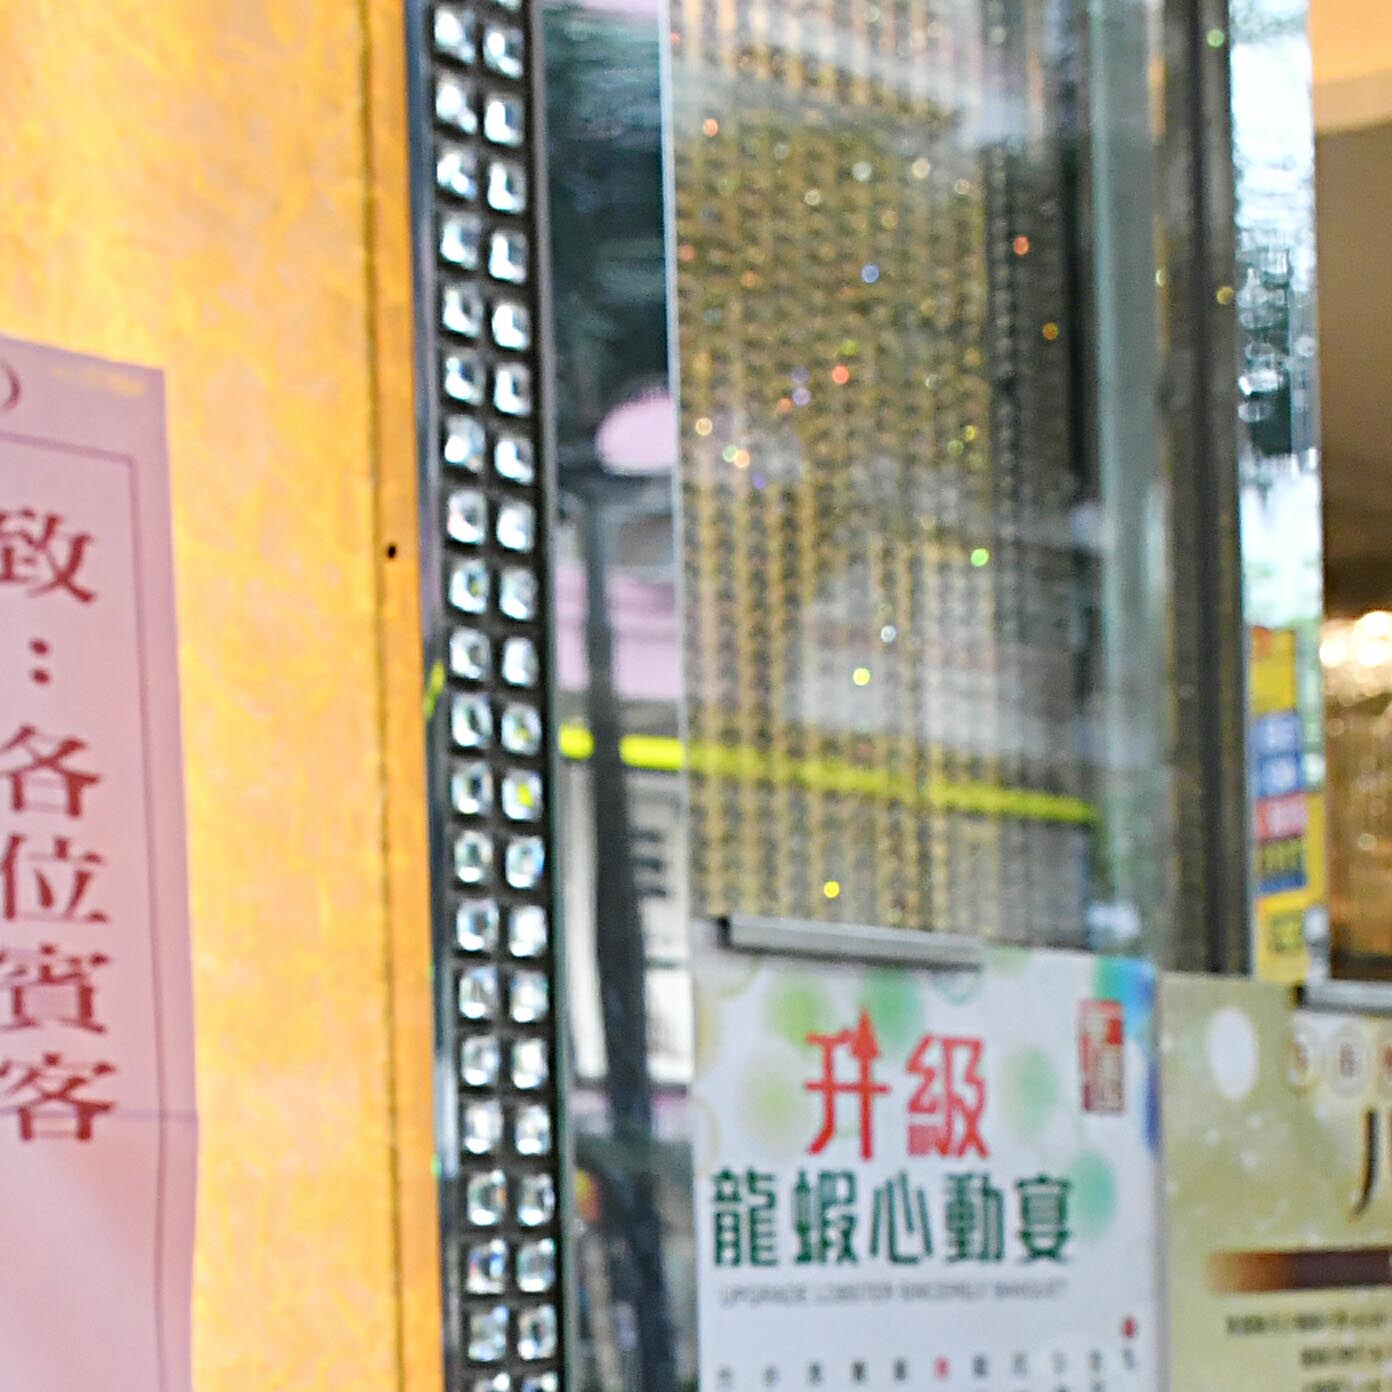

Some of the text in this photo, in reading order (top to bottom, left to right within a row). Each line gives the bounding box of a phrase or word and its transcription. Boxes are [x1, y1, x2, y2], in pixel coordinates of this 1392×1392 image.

[803, 1006, 990, 1162] 升級
[712, 1165, 1073, 1268] 龍蝦心動宴
